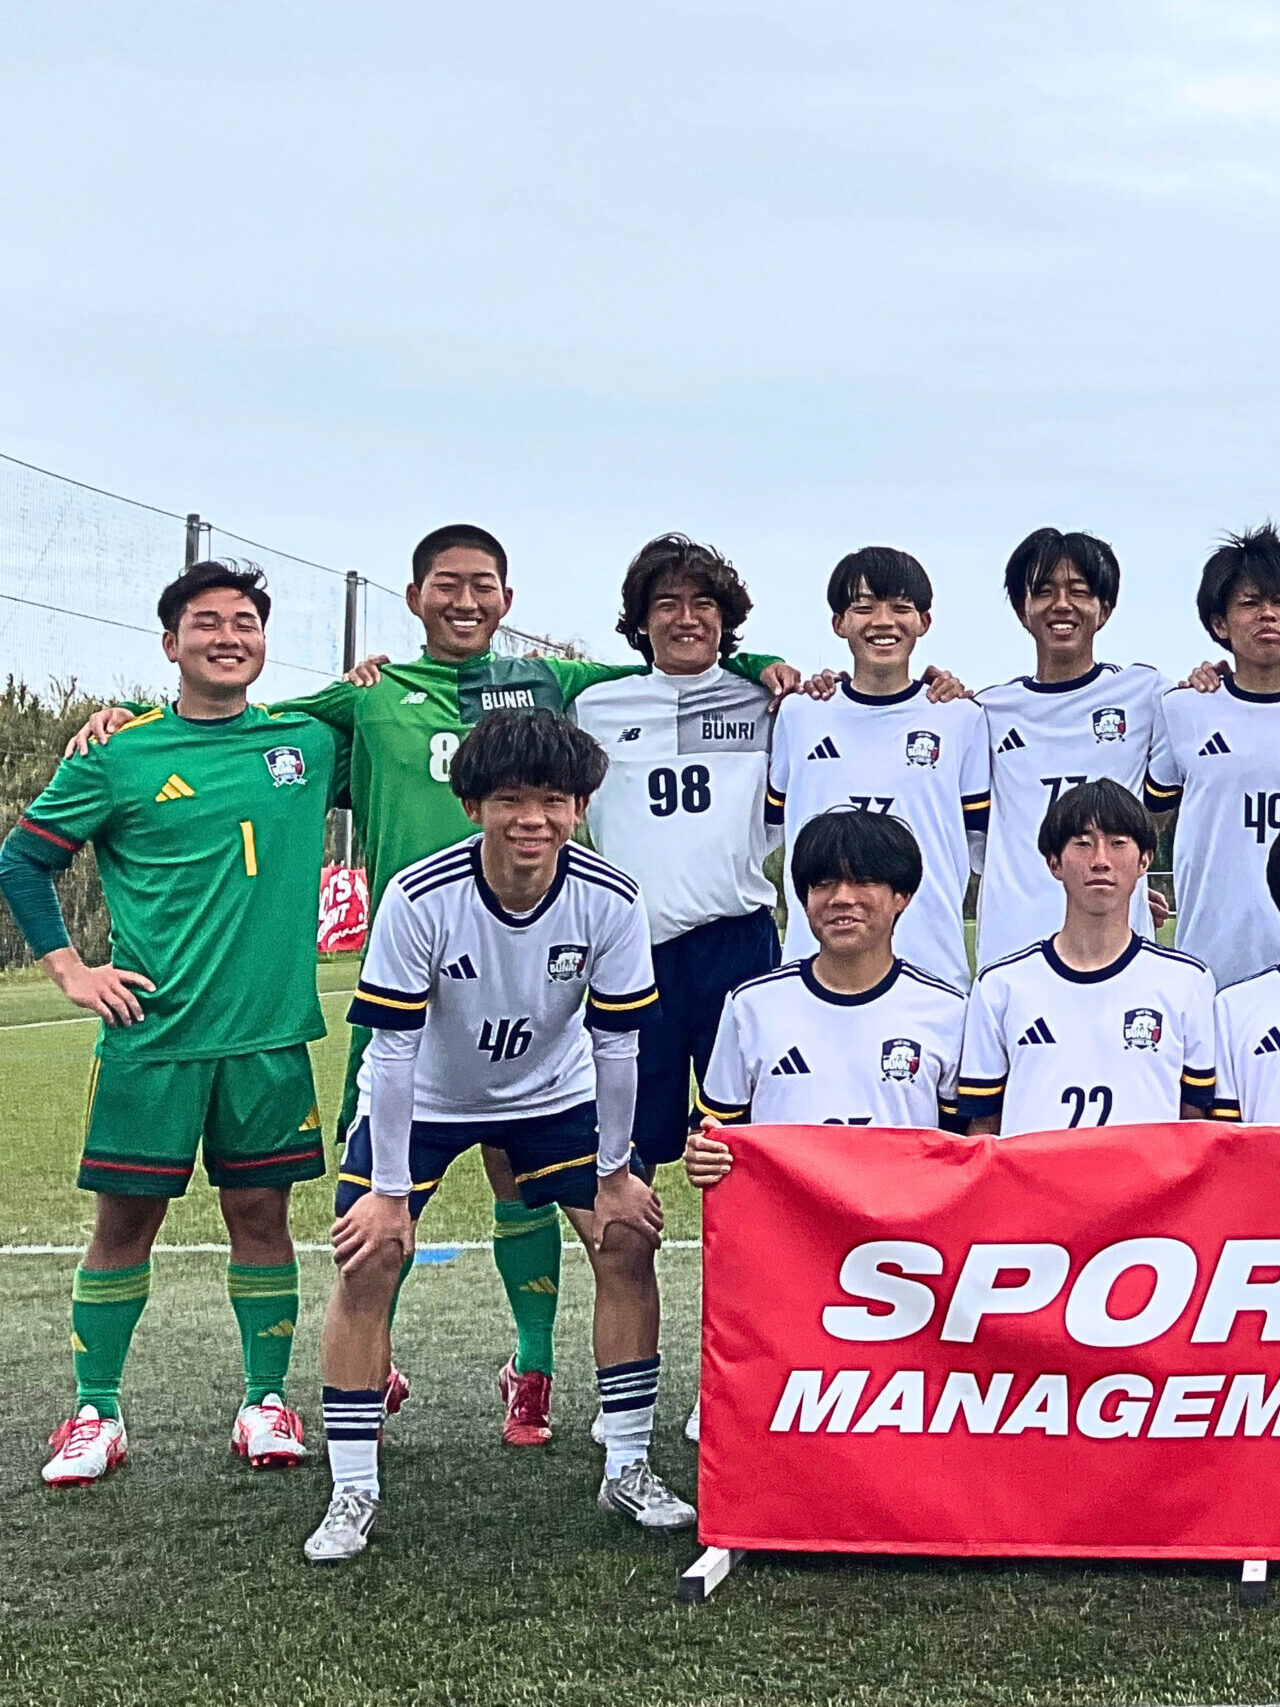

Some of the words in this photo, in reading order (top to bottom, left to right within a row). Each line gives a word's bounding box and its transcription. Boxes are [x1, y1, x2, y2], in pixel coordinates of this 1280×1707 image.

[482, 689, 535, 711] BUNRI
[702, 722, 756, 741] BUNRI
[648, 765, 711, 817] 98
[239, 819, 257, 876] 1
[478, 1016, 533, 1063] 46
[1060, 1085, 1113, 1129] 22
